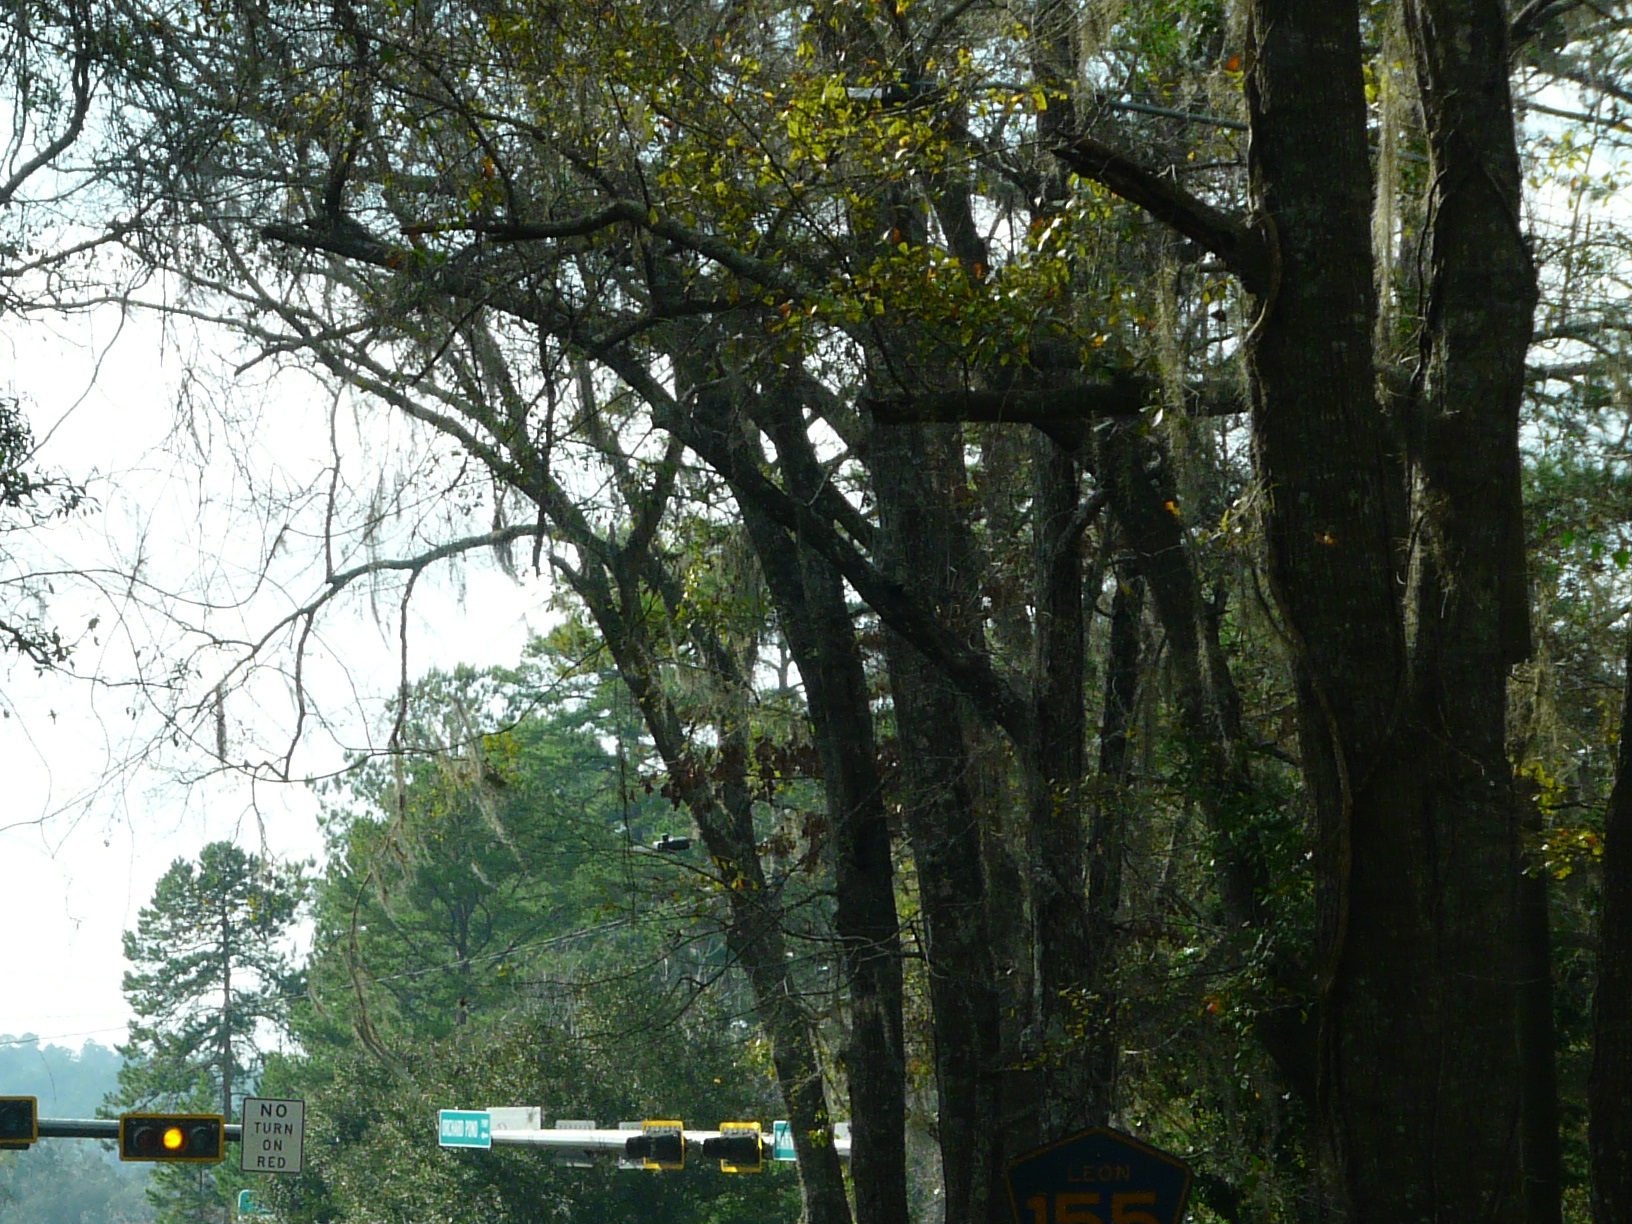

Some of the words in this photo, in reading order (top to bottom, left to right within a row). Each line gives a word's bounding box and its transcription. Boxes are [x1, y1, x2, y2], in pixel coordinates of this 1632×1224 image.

[260, 1103, 287, 1118] NO
[254, 1121, 293, 1136] TURN
[262, 1139, 282, 1152] ON
[257, 1156, 286, 1169] RED
[1068, 1164, 1130, 1182] LEON
